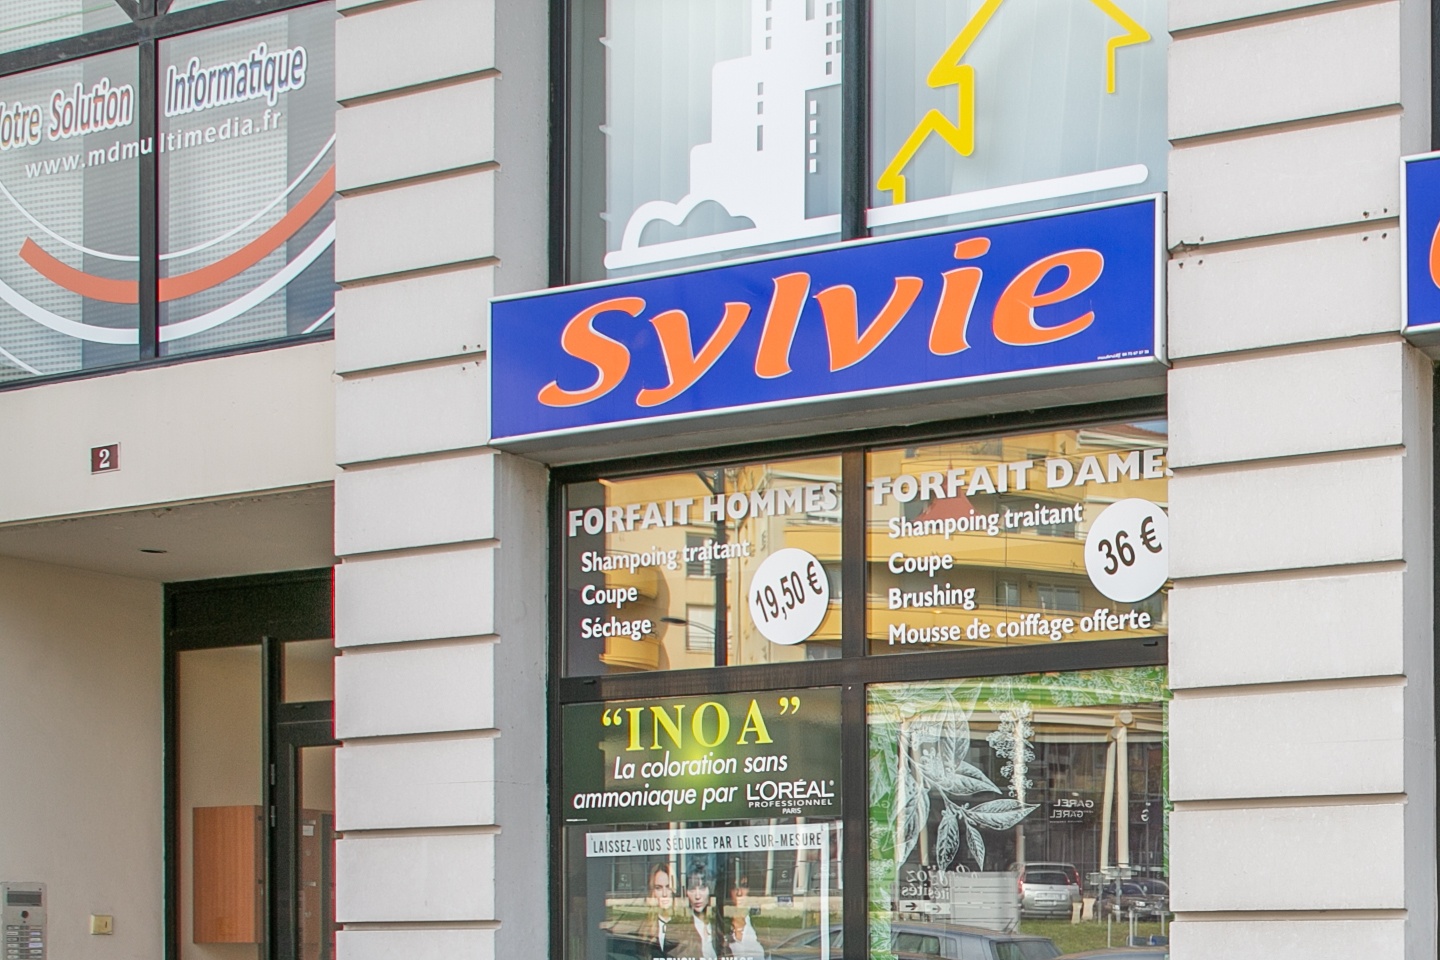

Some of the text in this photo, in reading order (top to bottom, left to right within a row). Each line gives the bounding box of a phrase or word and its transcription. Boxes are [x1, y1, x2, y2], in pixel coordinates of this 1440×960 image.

[165, 42, 306, 117] Informatique
[49, 77, 134, 141] Solution
[538, 236, 1104, 408] Sylvie
[98, 448, 111, 470] 2
[873, 459, 1034, 505] FORFAIT
[568, 482, 838, 537] FORFAIT HOMMES
[888, 502, 1083, 540] Shampoing traitant
[581, 539, 751, 574] Shampoing traitant
[1098, 516, 1163, 576] 36 €
[888, 552, 953, 577] Coupe
[581, 584, 638, 608] Coupe
[755, 561, 823, 622] 19,50 €
[888, 584, 976, 610] Brushing
[581, 617, 652, 641] Séchage
[888, 609, 1152, 646] Mousse de coiffage offerte
[614, 751, 788, 780] La coloration sans
[573, 783, 697, 812] ammoniaque
[702, 785, 739, 810] par
[749, 799, 833, 808] PROFESSIONNEL
[593, 832, 822, 854] LAISSEZ-VOUS SÉDUIRE PAR LE SUR-MESURE
